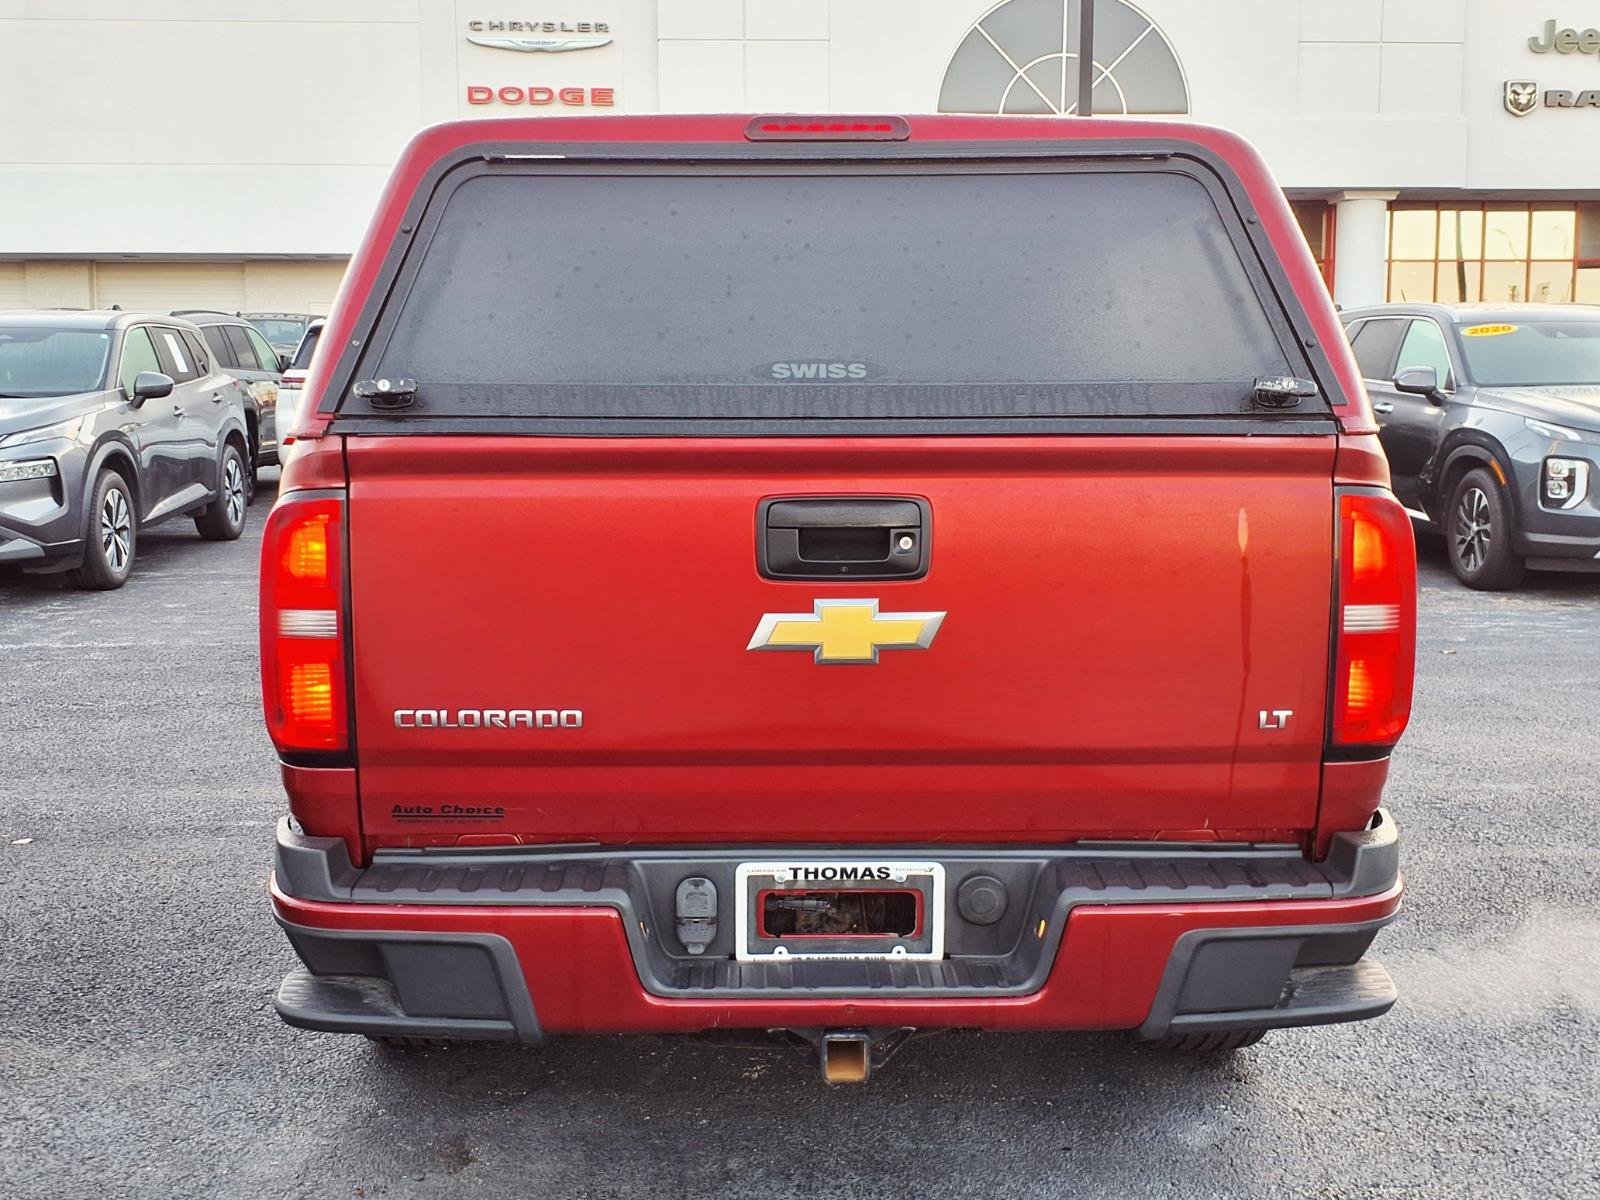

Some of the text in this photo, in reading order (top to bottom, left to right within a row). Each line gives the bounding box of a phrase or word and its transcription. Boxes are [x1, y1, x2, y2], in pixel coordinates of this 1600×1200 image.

[468, 20, 610, 33] CHRYSLER
[1527, 19, 1600, 63] Jee
[467, 86, 615, 106] DODGE
[1469, 325, 1512, 335] 2020
[771, 362, 867, 379] SWISS
[393, 708, 584, 729] COLORADO
[1259, 709, 1294, 729] LT
[392, 804, 505, 815] Auto Choice
[788, 866, 891, 880] THOMAS
